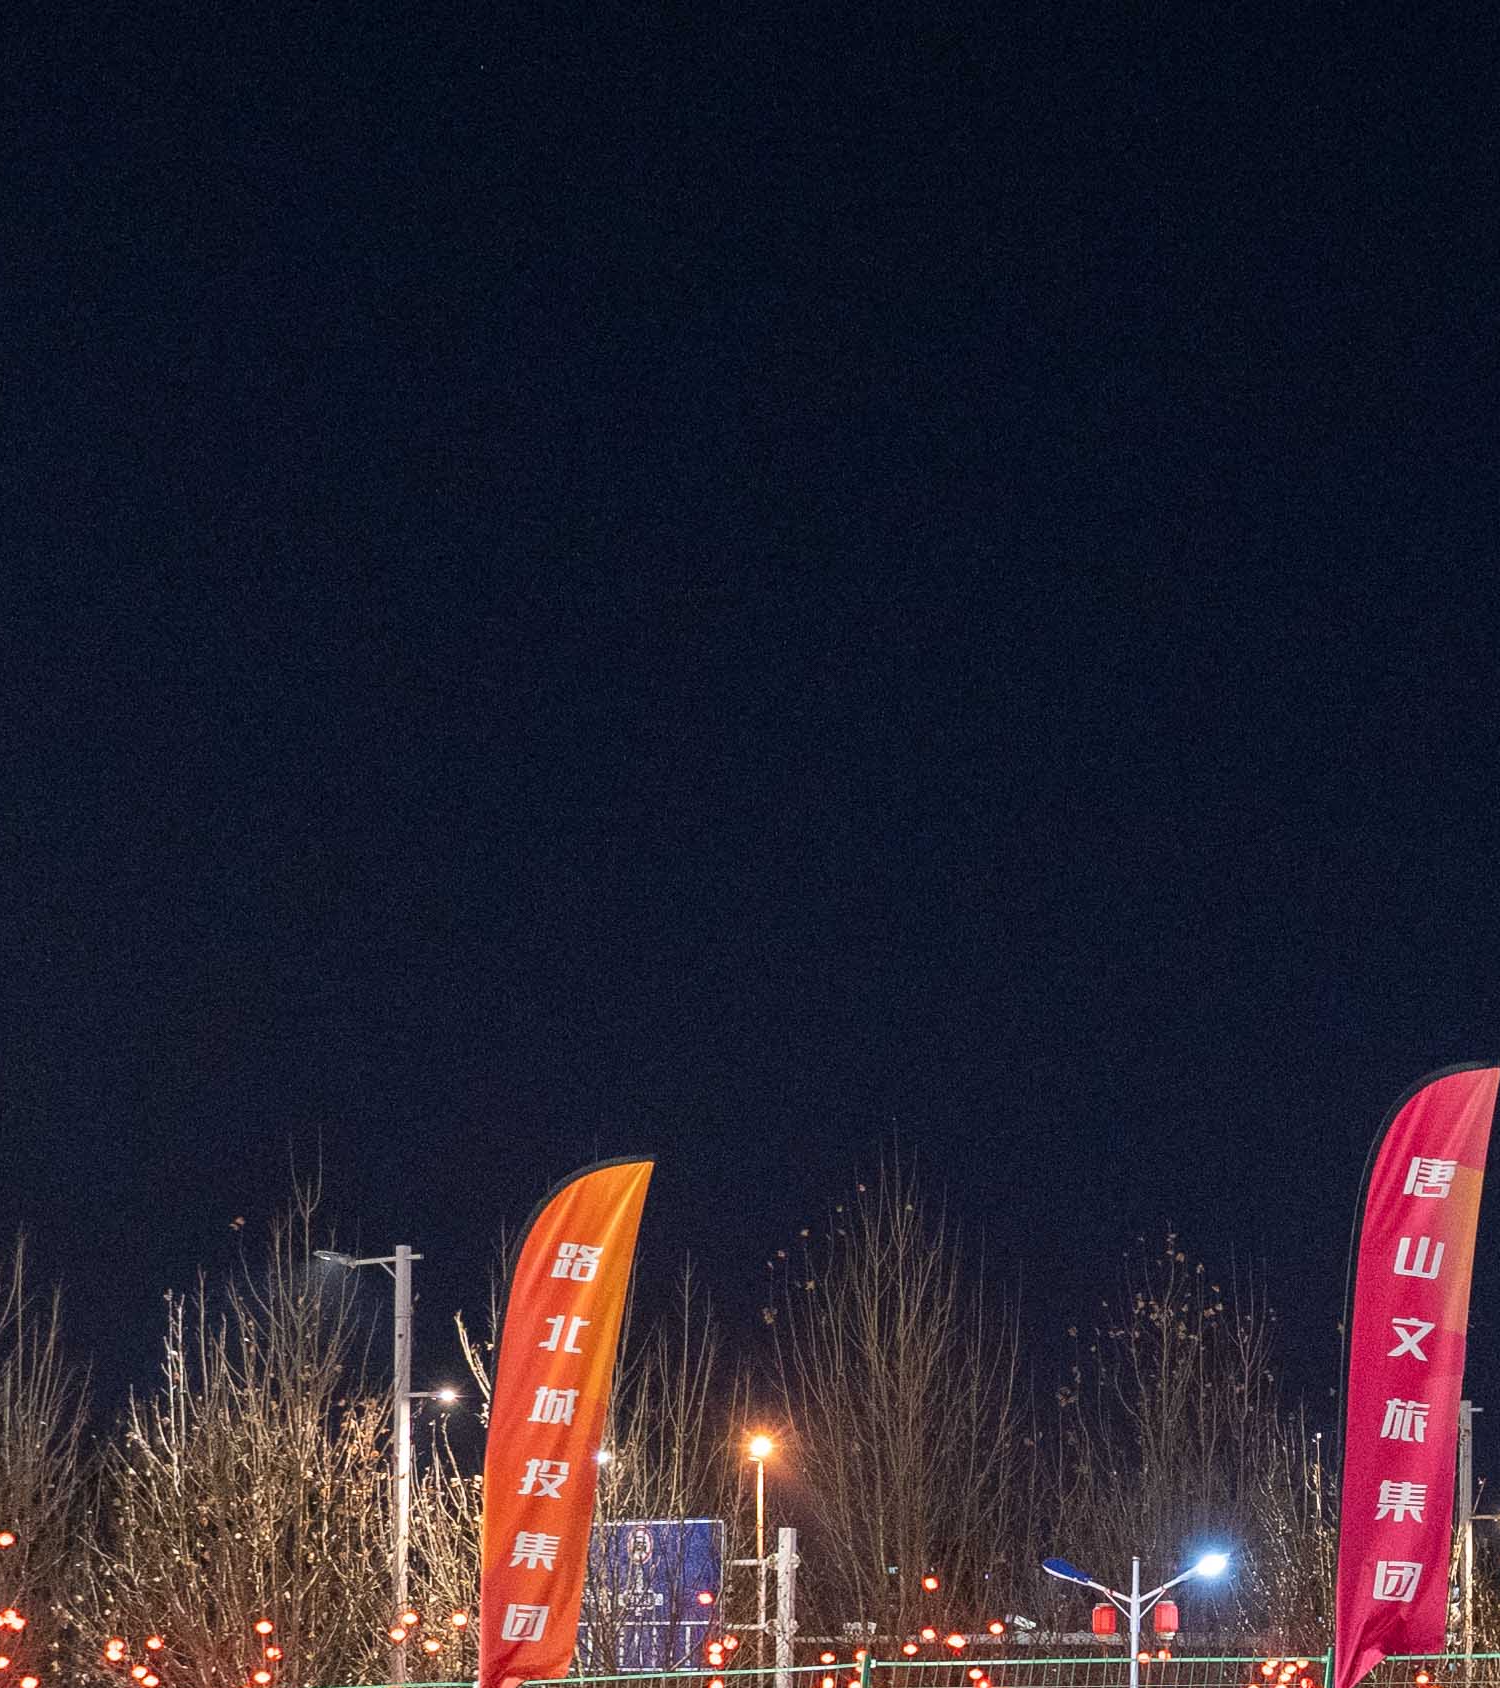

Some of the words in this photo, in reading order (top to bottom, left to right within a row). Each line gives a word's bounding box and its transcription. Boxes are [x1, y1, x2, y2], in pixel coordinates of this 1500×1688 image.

[502, 1242, 604, 1643] 路北城投集团
[1372, 1157, 1457, 1603] 唐山文旅集团
